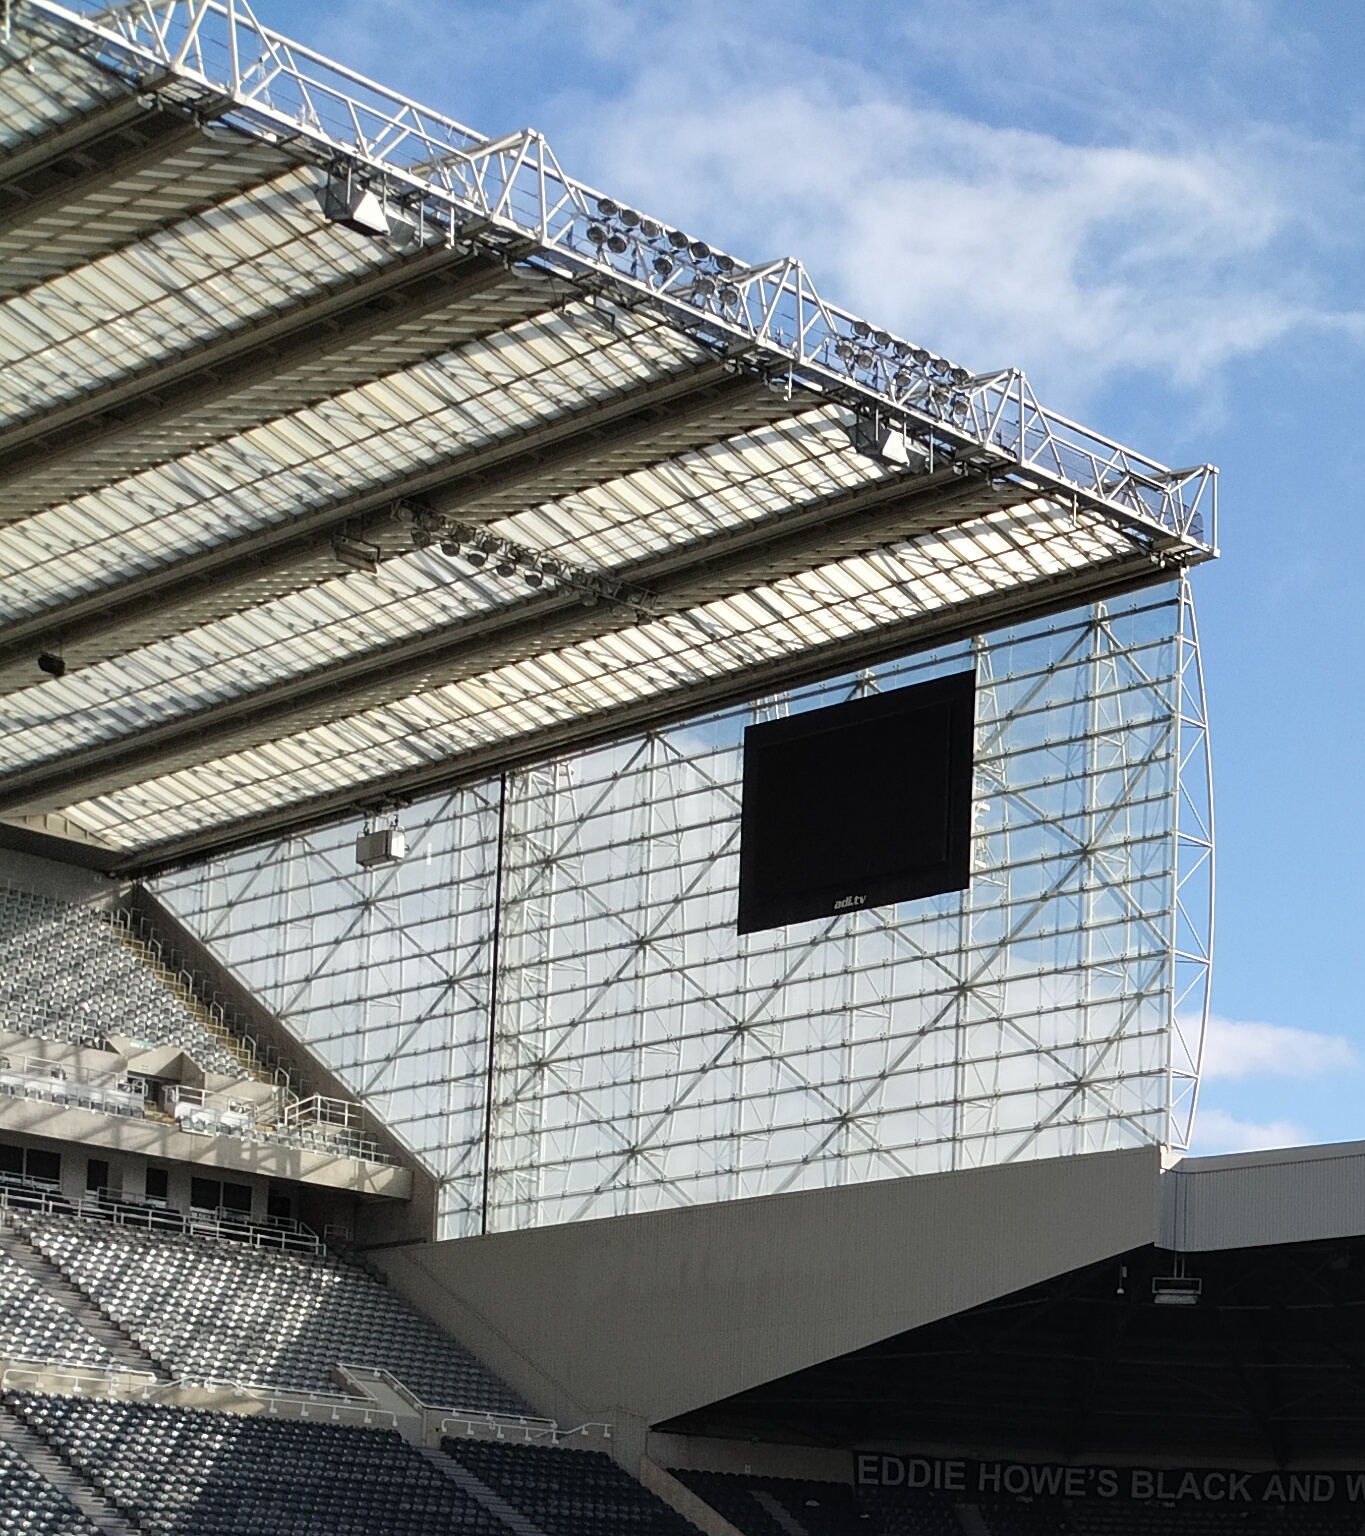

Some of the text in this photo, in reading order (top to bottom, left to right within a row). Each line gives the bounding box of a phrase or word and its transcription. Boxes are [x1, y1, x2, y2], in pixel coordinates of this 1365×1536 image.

[857, 1454, 966, 1490] EDDIE
[978, 1463, 1119, 1498] HOWE'S
[1130, 1470, 1252, 1501] BLACK
[1262, 1474, 1335, 1501] AND
